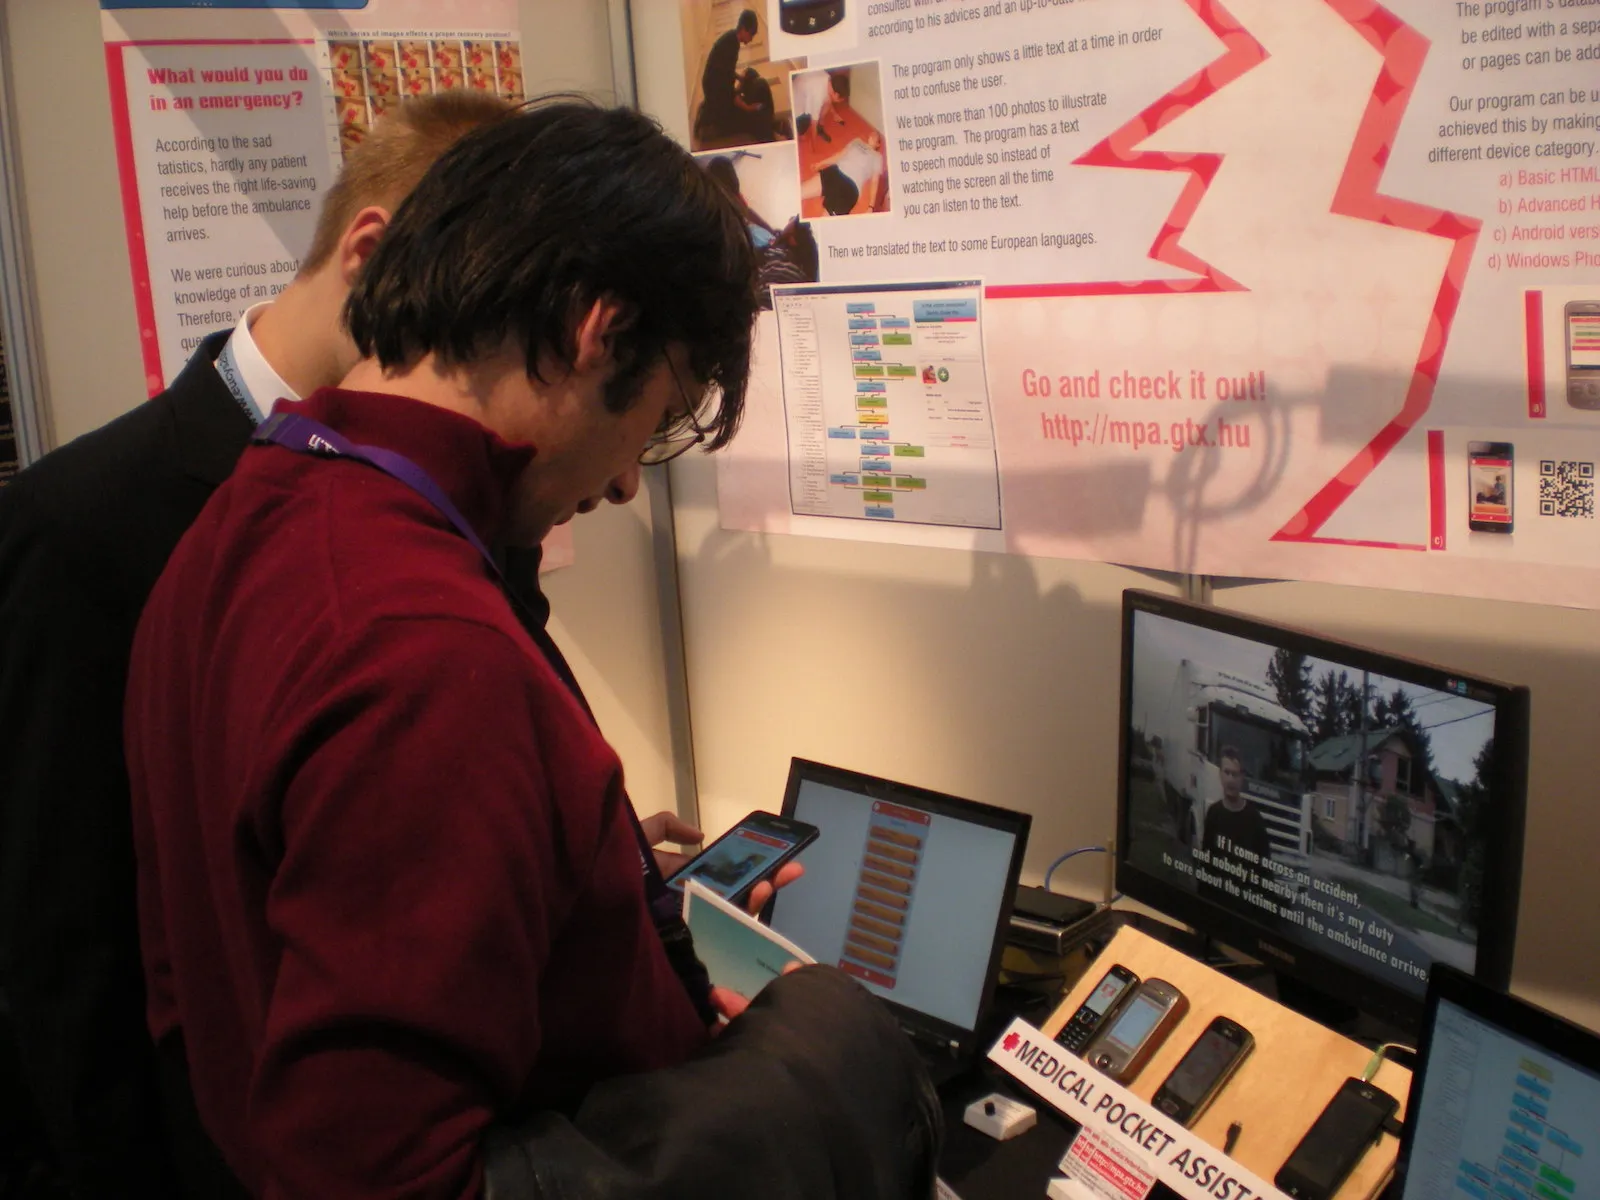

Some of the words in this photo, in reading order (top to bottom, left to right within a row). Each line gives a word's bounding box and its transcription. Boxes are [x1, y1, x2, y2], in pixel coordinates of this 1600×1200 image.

[1456, 2, 1479, 16] The
[1484, 0, 1554, 18] program's
[1462, 29, 1477, 44] be
[1482, 24, 1522, 41] edited
[1527, 22, 1555, 37] with
[1560, 22, 1567, 35] a
[892, 64, 909, 77] The
[912, 59, 951, 77] program
[954, 54, 974, 69] only
[978, 50, 1010, 65] shows
[1014, 48, 1020, 60] a
[1022, 44, 1043, 58] little
[1046, 40, 1065, 55] text
[1068, 38, 1078, 52] at
[1081, 38, 1088, 50] a
[1090, 34, 1114, 48] time
[1118, 30, 1128, 45] in
[1132, 27, 1162, 43] order
[1462, 57, 1475, 69] or
[1480, 53, 1520, 70] pages
[1526, 51, 1550, 64] can
[1555, 47, 1571, 62] be
[148, 68, 194, 84] What
[201, 68, 249, 82] would
[255, 69, 283, 84] you
[289, 66, 308, 80] do
[150, 95, 167, 110] in
[174, 96, 194, 109] an
[200, 91, 302, 109] emergency?
[896, 116, 912, 128] We
[914, 112, 935, 127] took
[937, 111, 961, 123] more
[964, 108, 985, 121] than
[988, 102, 1008, 117] 100
[1012, 100, 1045, 117] photos
[1048, 98, 1059, 111] to
[1062, 92, 1106, 108] illustrate
[1450, 95, 1473, 111] Our
[1478, 94, 1534, 112] program
[1540, 92, 1564, 105] can
[1570, 88, 1586, 103] be
[898, 138, 913, 150] the
[916, 134, 956, 151] program.
[963, 129, 981, 143] The
[984, 126, 1026, 143] program
[1029, 123, 1048, 136] has
[1051, 122, 1057, 134] a
[1060, 118, 1079, 133] text
[1439, 119, 1497, 137] achieved
[1502, 118, 1526, 132] this
[1532, 117, 1547, 134] by
[156, 137, 215, 152] According
[218, 135, 229, 149] to
[232, 136, 248, 148] the
[253, 134, 272, 147] sad
[1428, 146, 1481, 162] different
[1486, 144, 1530, 159] device
[1535, 142, 1598, 158] category.
[158, 160, 207, 174] tatistics,
[211, 157, 244, 172] hardly
[248, 159, 267, 171] any
[271, 155, 307, 170] patient
[161, 182, 209, 196] receives
[212, 180, 230, 193] the
[234, 178, 258, 194] right
[261, 177, 316, 190] life-saving
[902, 179, 944, 193] watching
[946, 176, 961, 189] the
[964, 175, 996, 188] screen
[1000, 171, 1010, 185] all
[1012, 170, 1028, 184] the
[1031, 169, 1053, 182] time
[1500, 172, 1513, 188] a)
[1518, 170, 1555, 185] Basic
[163, 205, 188, 220] help
[192, 203, 228, 217] before
[231, 201, 248, 214] the
[252, 199, 310, 212] ambulance
[1499, 198, 1513, 216] b)
[1518, 196, 1585, 212] Advanced
[167, 227, 209, 241] arrives.
[1494, 226, 1506, 244] c)
[1512, 225, 1564, 240] Android
[828, 245, 848, 257] Then
[851, 246, 863, 256] we
[866, 242, 909, 256] translated
[912, 241, 926, 253] the
[929, 240, 946, 252] text
[948, 240, 958, 251] to
[961, 238, 988, 250] some
[991, 235, 1037, 249] European
[1041, 233, 1096, 248] languages.
[1488, 253, 1501, 271] d)
[1507, 253, 1569, 267] Windows
[171, 268, 191, 282] We
[195, 267, 222, 280] were
[226, 263, 266, 277] curious
[175, 288, 236, 304] knowledge
[240, 284, 250, 298] of
[254, 285, 267, 296] an
[177, 310, 236, 326] Therefore,
[1023, 368, 1051, 397] Go
[1059, 370, 1100, 398] and
[1109, 370, 1182, 400] check
[1190, 370, 1206, 400] it
[1216, 370, 1266, 400] out!
[1041, 412, 1250, 452] http://mpa.gtx.hu
[1217, 835, 1225, 849] If
[1228, 839, 1231, 852] I
[1234, 845, 1259, 864] come
[1262, 857, 1294, 879] across
[1297, 873, 1310, 886] an
[1314, 878, 1362, 909] accident,
[1192, 848, 1210, 863] and
[1213, 856, 1248, 882] nobody
[1251, 869, 1259, 884] is
[1262, 878, 1297, 904] nearby
[1301, 891, 1323, 913] then
[1327, 902, 1344, 922] it's
[1348, 915, 1364, 934] my
[1368, 920, 1394, 946] duty
[1163, 852, 1172, 866] to
[1174, 860, 1193, 876] care
[1196, 867, 1222, 888] about
[1225, 880, 1240, 896] the
[1242, 889, 1277, 914] victims
[1280, 906, 1304, 926] until
[1307, 916, 1324, 934] the
[1327, 929, 1387, 964] ambulance
[1391, 956, 1430, 982] arrive.
[1015, 1040, 1095, 1106] MEDICAL
[1093, 1093, 1176, 1156] POCKET
[1169, 1149, 1263, 1200] ASSIST
